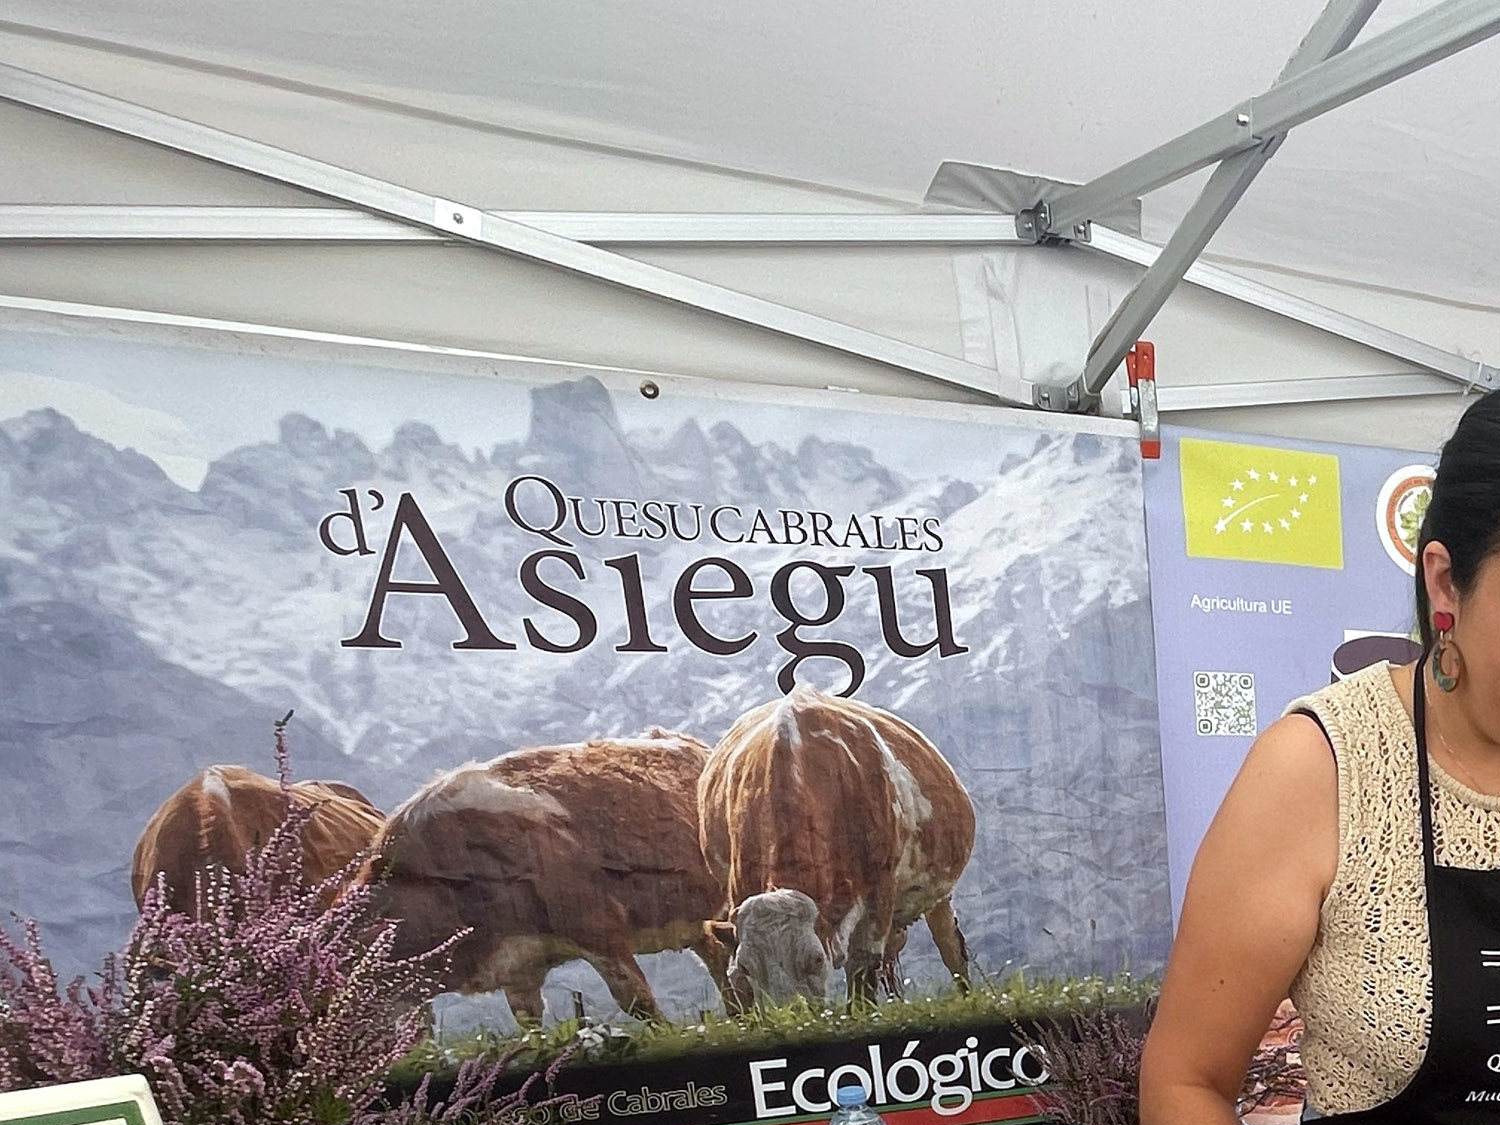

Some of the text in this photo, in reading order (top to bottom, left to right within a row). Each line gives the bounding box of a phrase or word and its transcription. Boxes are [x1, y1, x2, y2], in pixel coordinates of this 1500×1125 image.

[504, 475, 944, 553] QUESU CABRALES
[1190, 593, 1293, 615] Agricultura UE
[559, 1094, 600, 1121] de
[607, 1081, 729, 1116] Cabrales
[749, 1035, 1053, 1119] Ecológico
